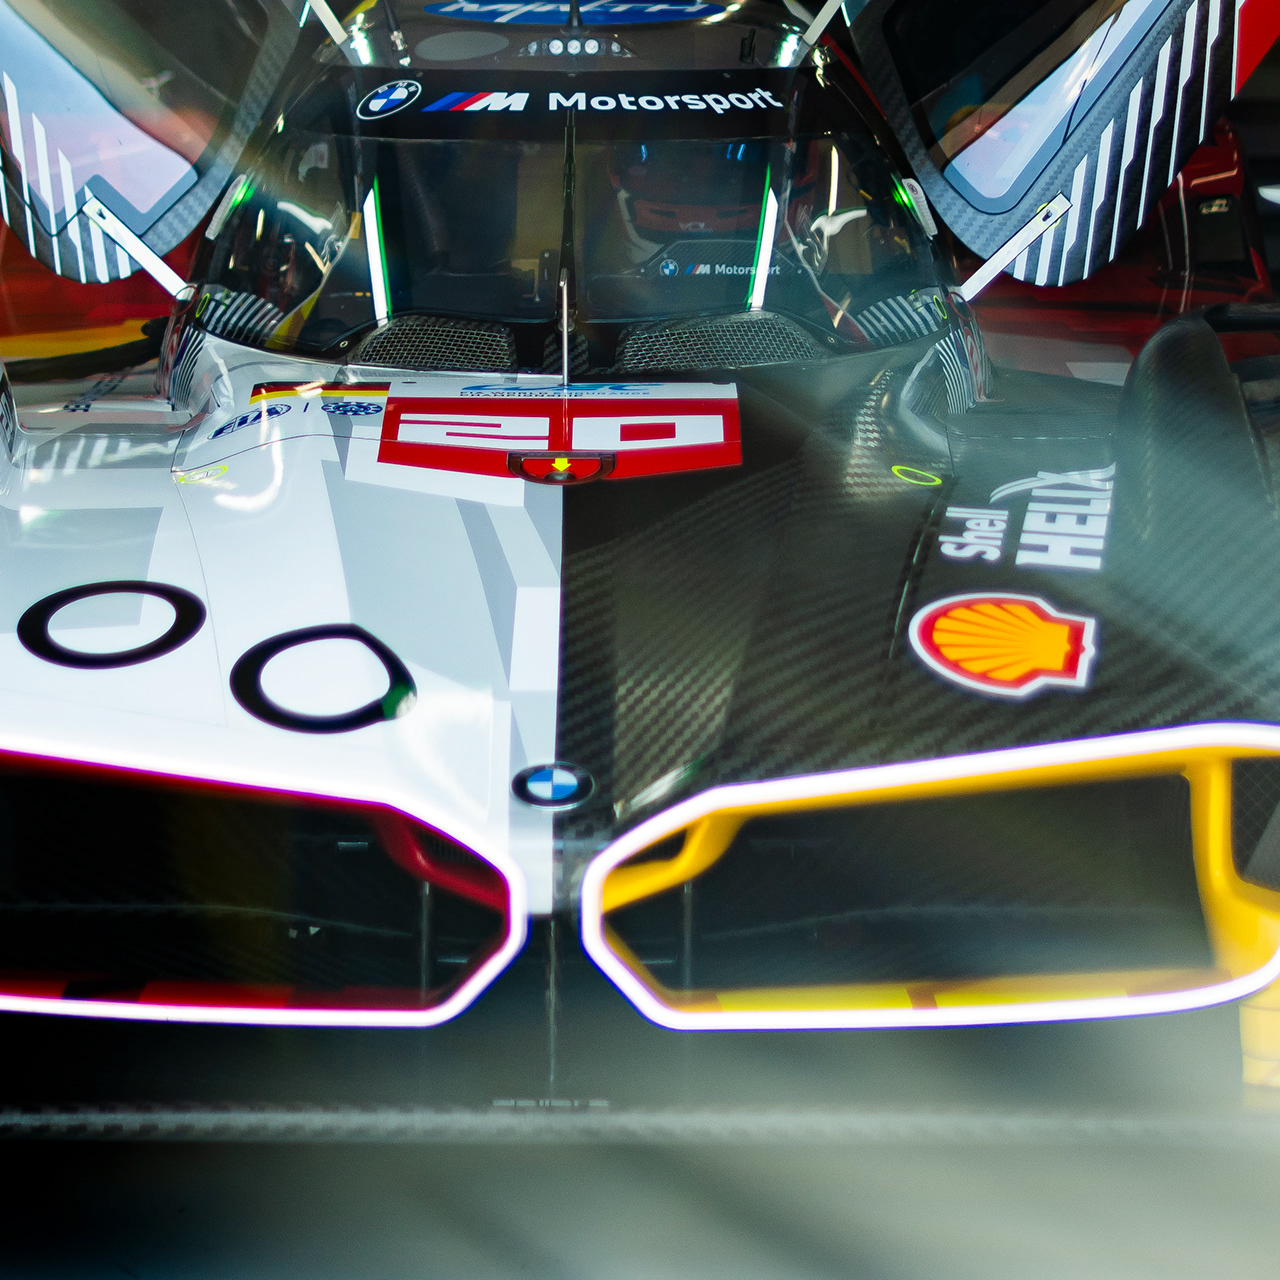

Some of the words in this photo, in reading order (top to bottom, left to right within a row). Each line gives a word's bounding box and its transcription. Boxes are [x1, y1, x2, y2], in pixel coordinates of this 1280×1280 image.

[548, 87, 784, 114] Motorsport
[714, 263, 781, 276] Motorsort
[937, 506, 1010, 561] Shell
[1014, 461, 1117, 570] HELIX
